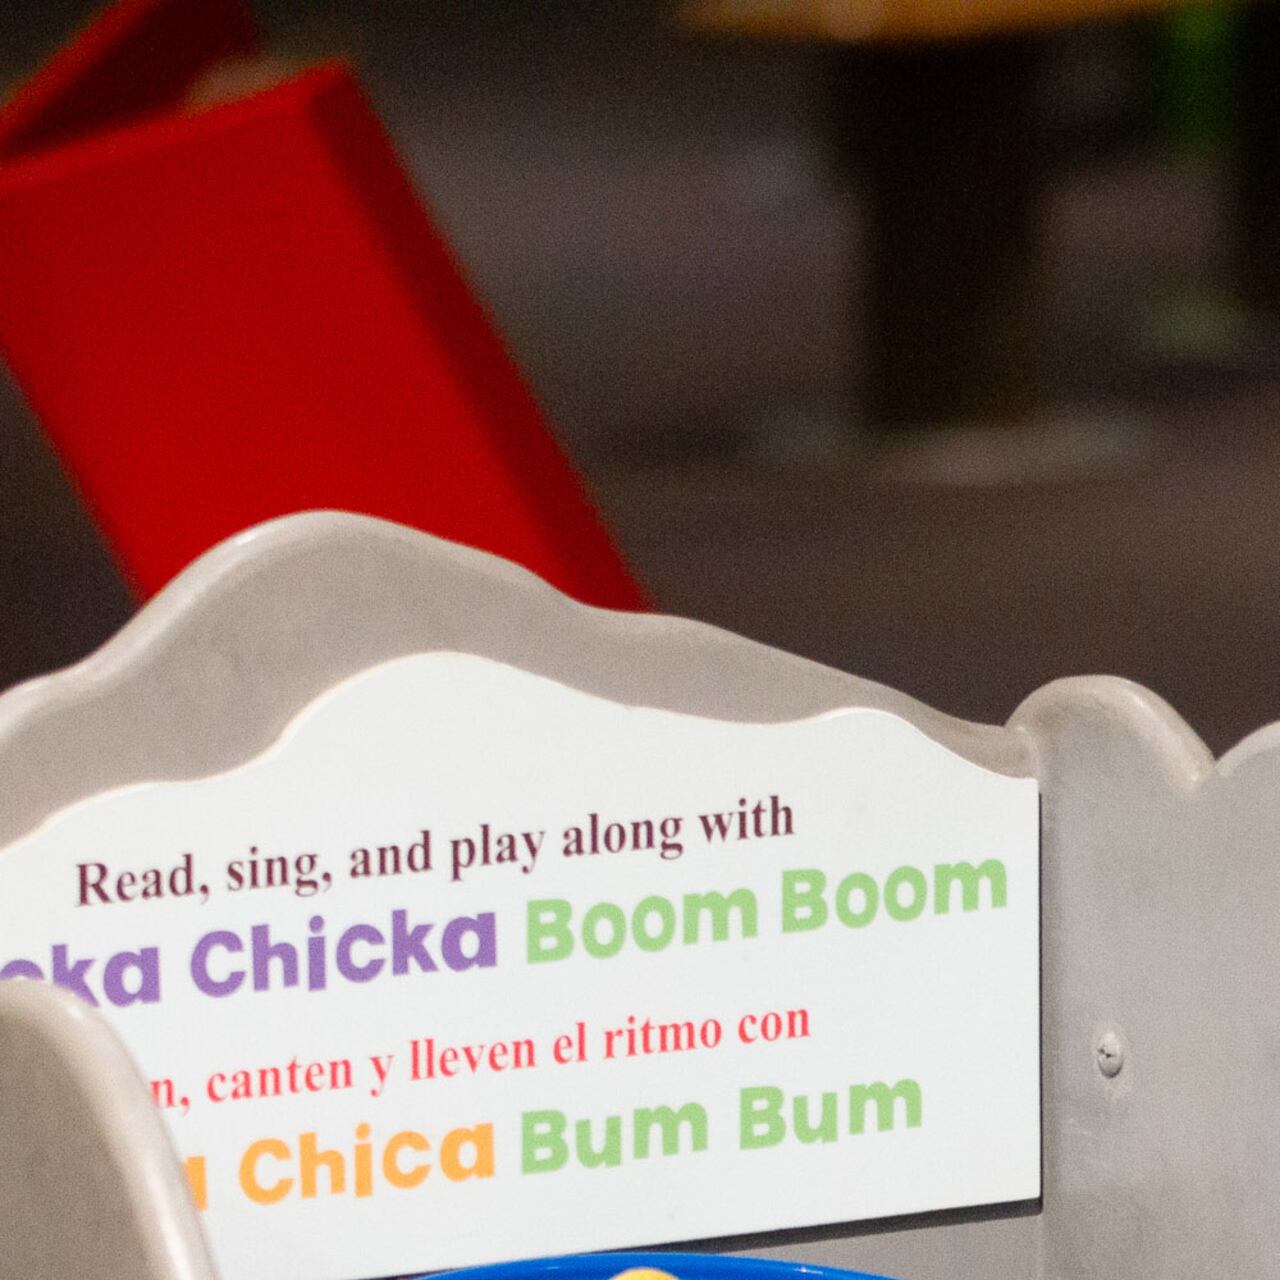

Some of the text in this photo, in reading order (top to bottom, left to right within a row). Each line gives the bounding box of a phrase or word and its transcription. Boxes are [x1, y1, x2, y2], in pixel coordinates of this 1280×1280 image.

[75, 795, 795, 907] Read, sing, and play along with
[190, 909, 498, 998] Chicka
[526, 888, 759, 964] Boom
[781, 858, 1008, 934] Boom
[206, 1056, 353, 1104] canten
[370, 1055, 395, 1098] y
[410, 1038, 536, 1082] lleven
[553, 1021, 588, 1066] el
[603, 1016, 723, 1060] ritmo
[737, 1007, 811, 1044] con
[238, 1121, 497, 1207] Chica
[520, 1101, 709, 1176] Bum
[739, 1078, 923, 1151] Bum
